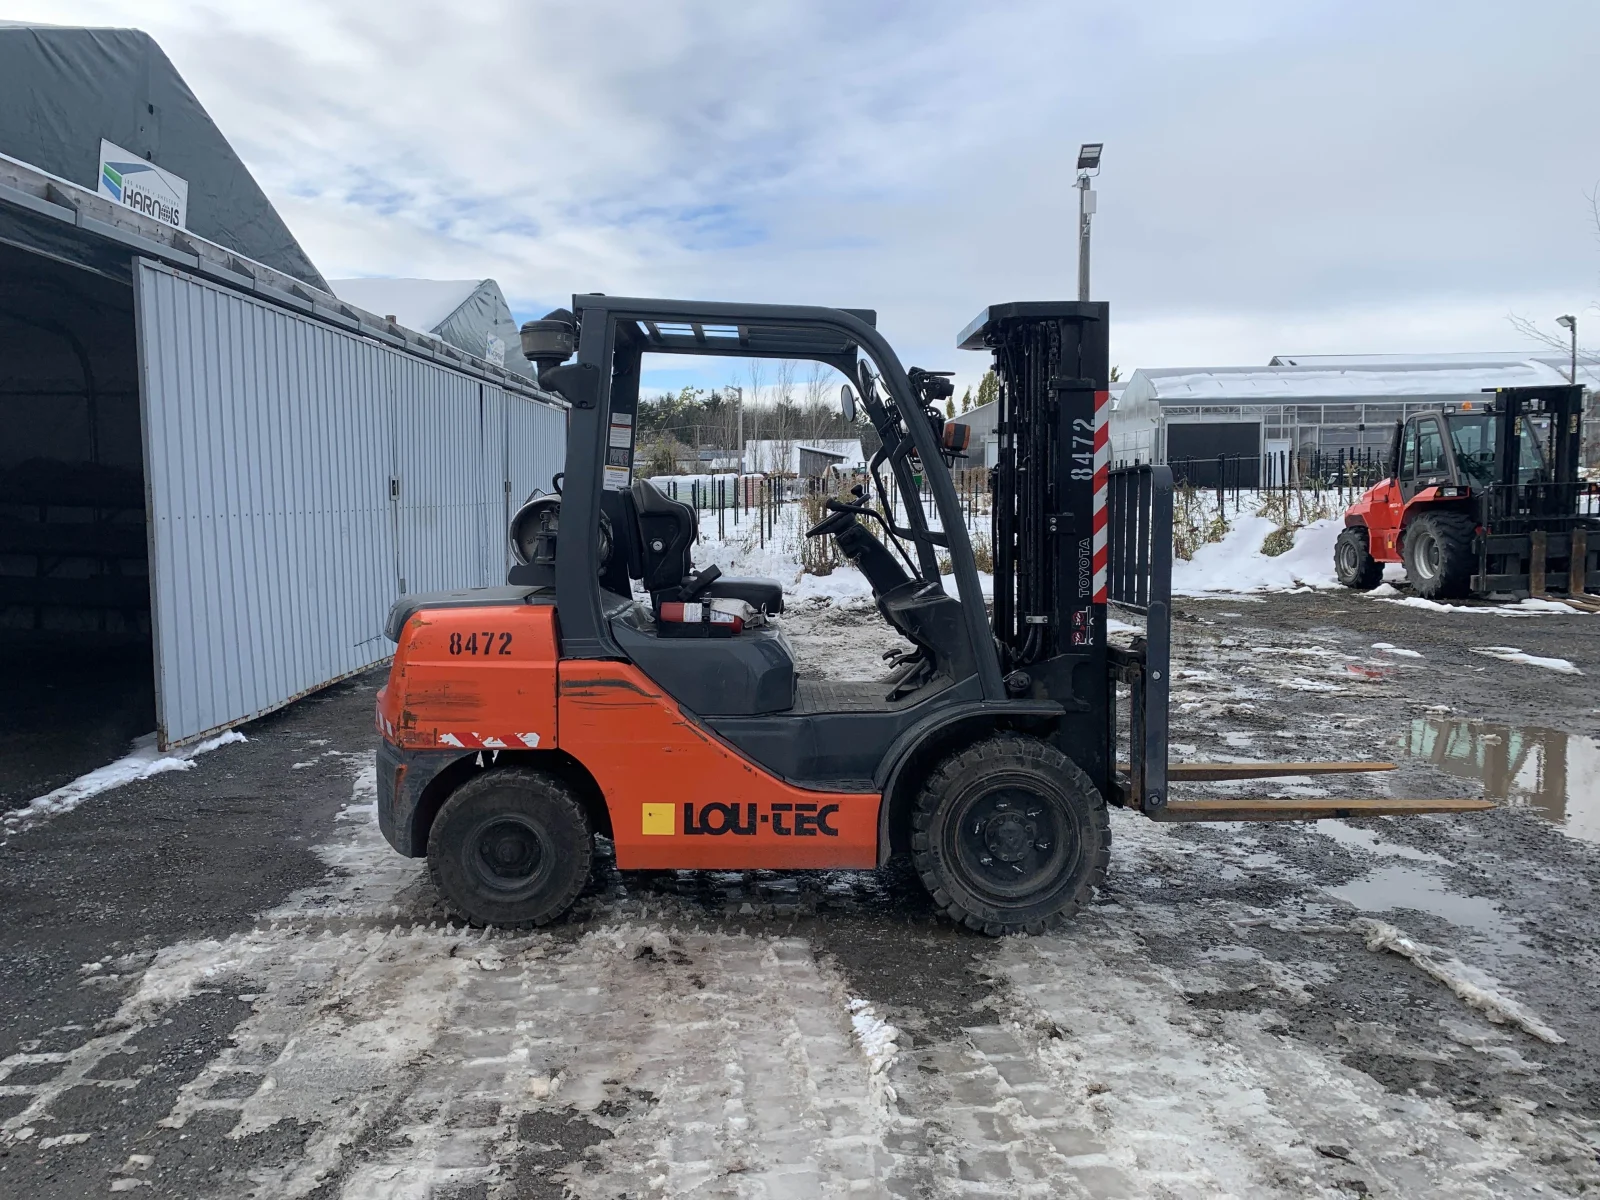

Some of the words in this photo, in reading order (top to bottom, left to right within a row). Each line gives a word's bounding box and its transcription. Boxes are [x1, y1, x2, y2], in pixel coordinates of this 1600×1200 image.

[1070, 418, 1095, 480] 8472
[1078, 538, 1090, 598] TOYOTA
[449, 631, 513, 656] 8472
[683, 802, 839, 836] LOU-TEC
